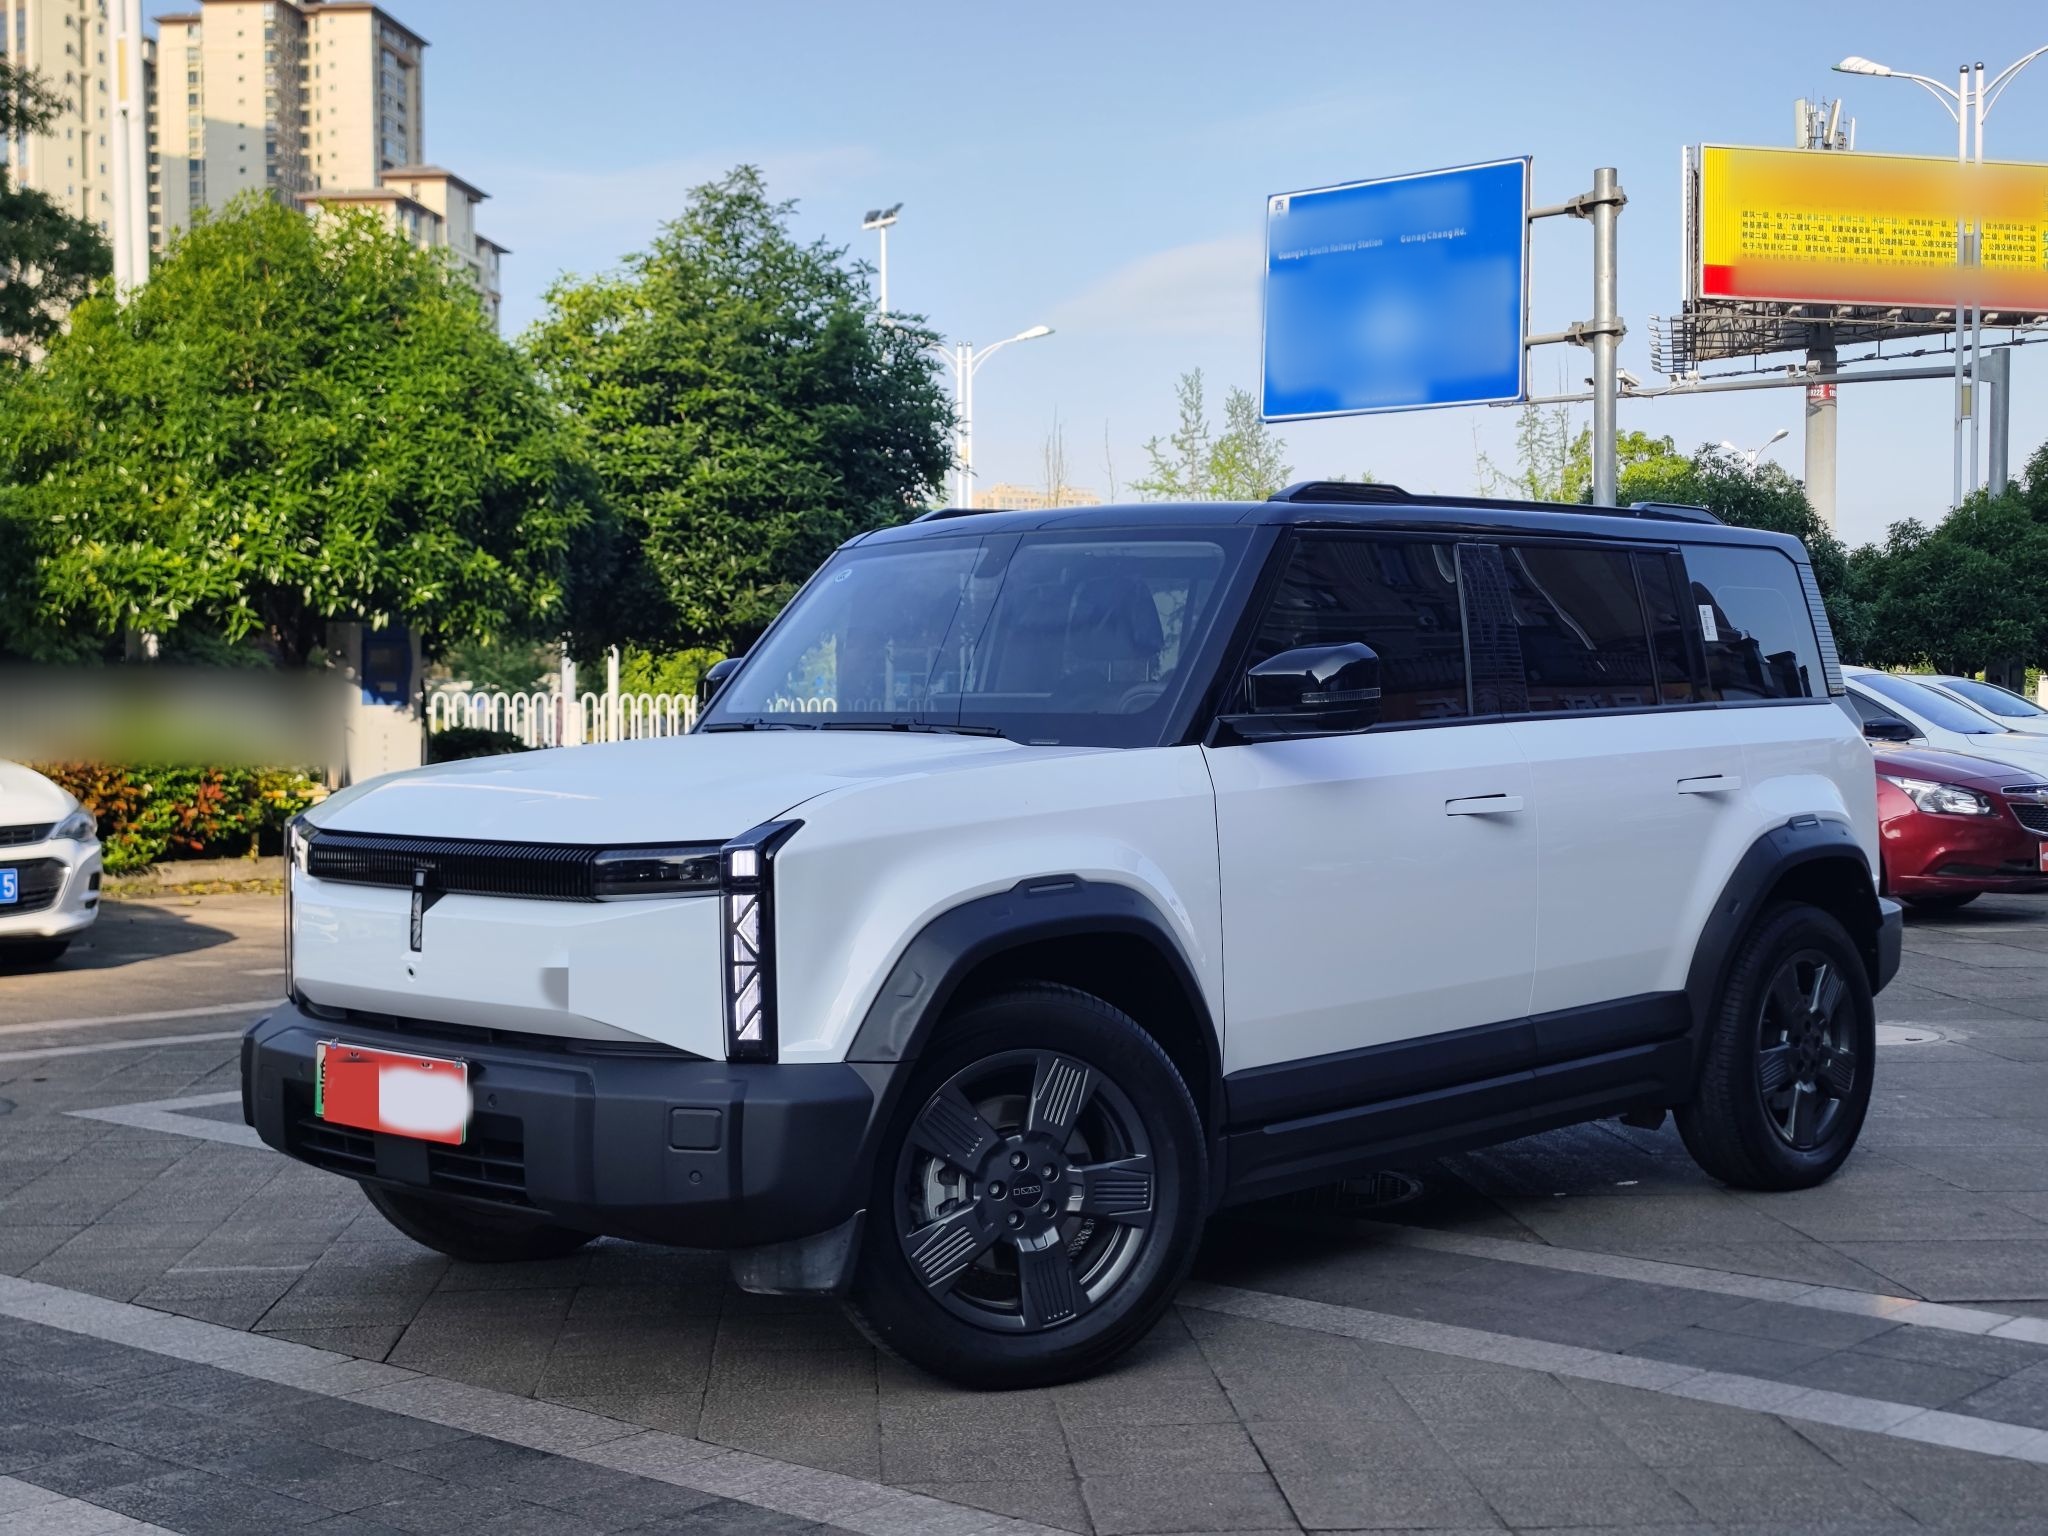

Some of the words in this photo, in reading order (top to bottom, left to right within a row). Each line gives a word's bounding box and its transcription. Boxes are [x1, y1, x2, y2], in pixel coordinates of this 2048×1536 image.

[1275, 200, 1284, 211] 西
[1309, 245, 1328, 255] South
[1330, 242, 1356, 251] Railway
[1357, 239, 1383, 249] Station
[4, 874, 15, 898] 5
